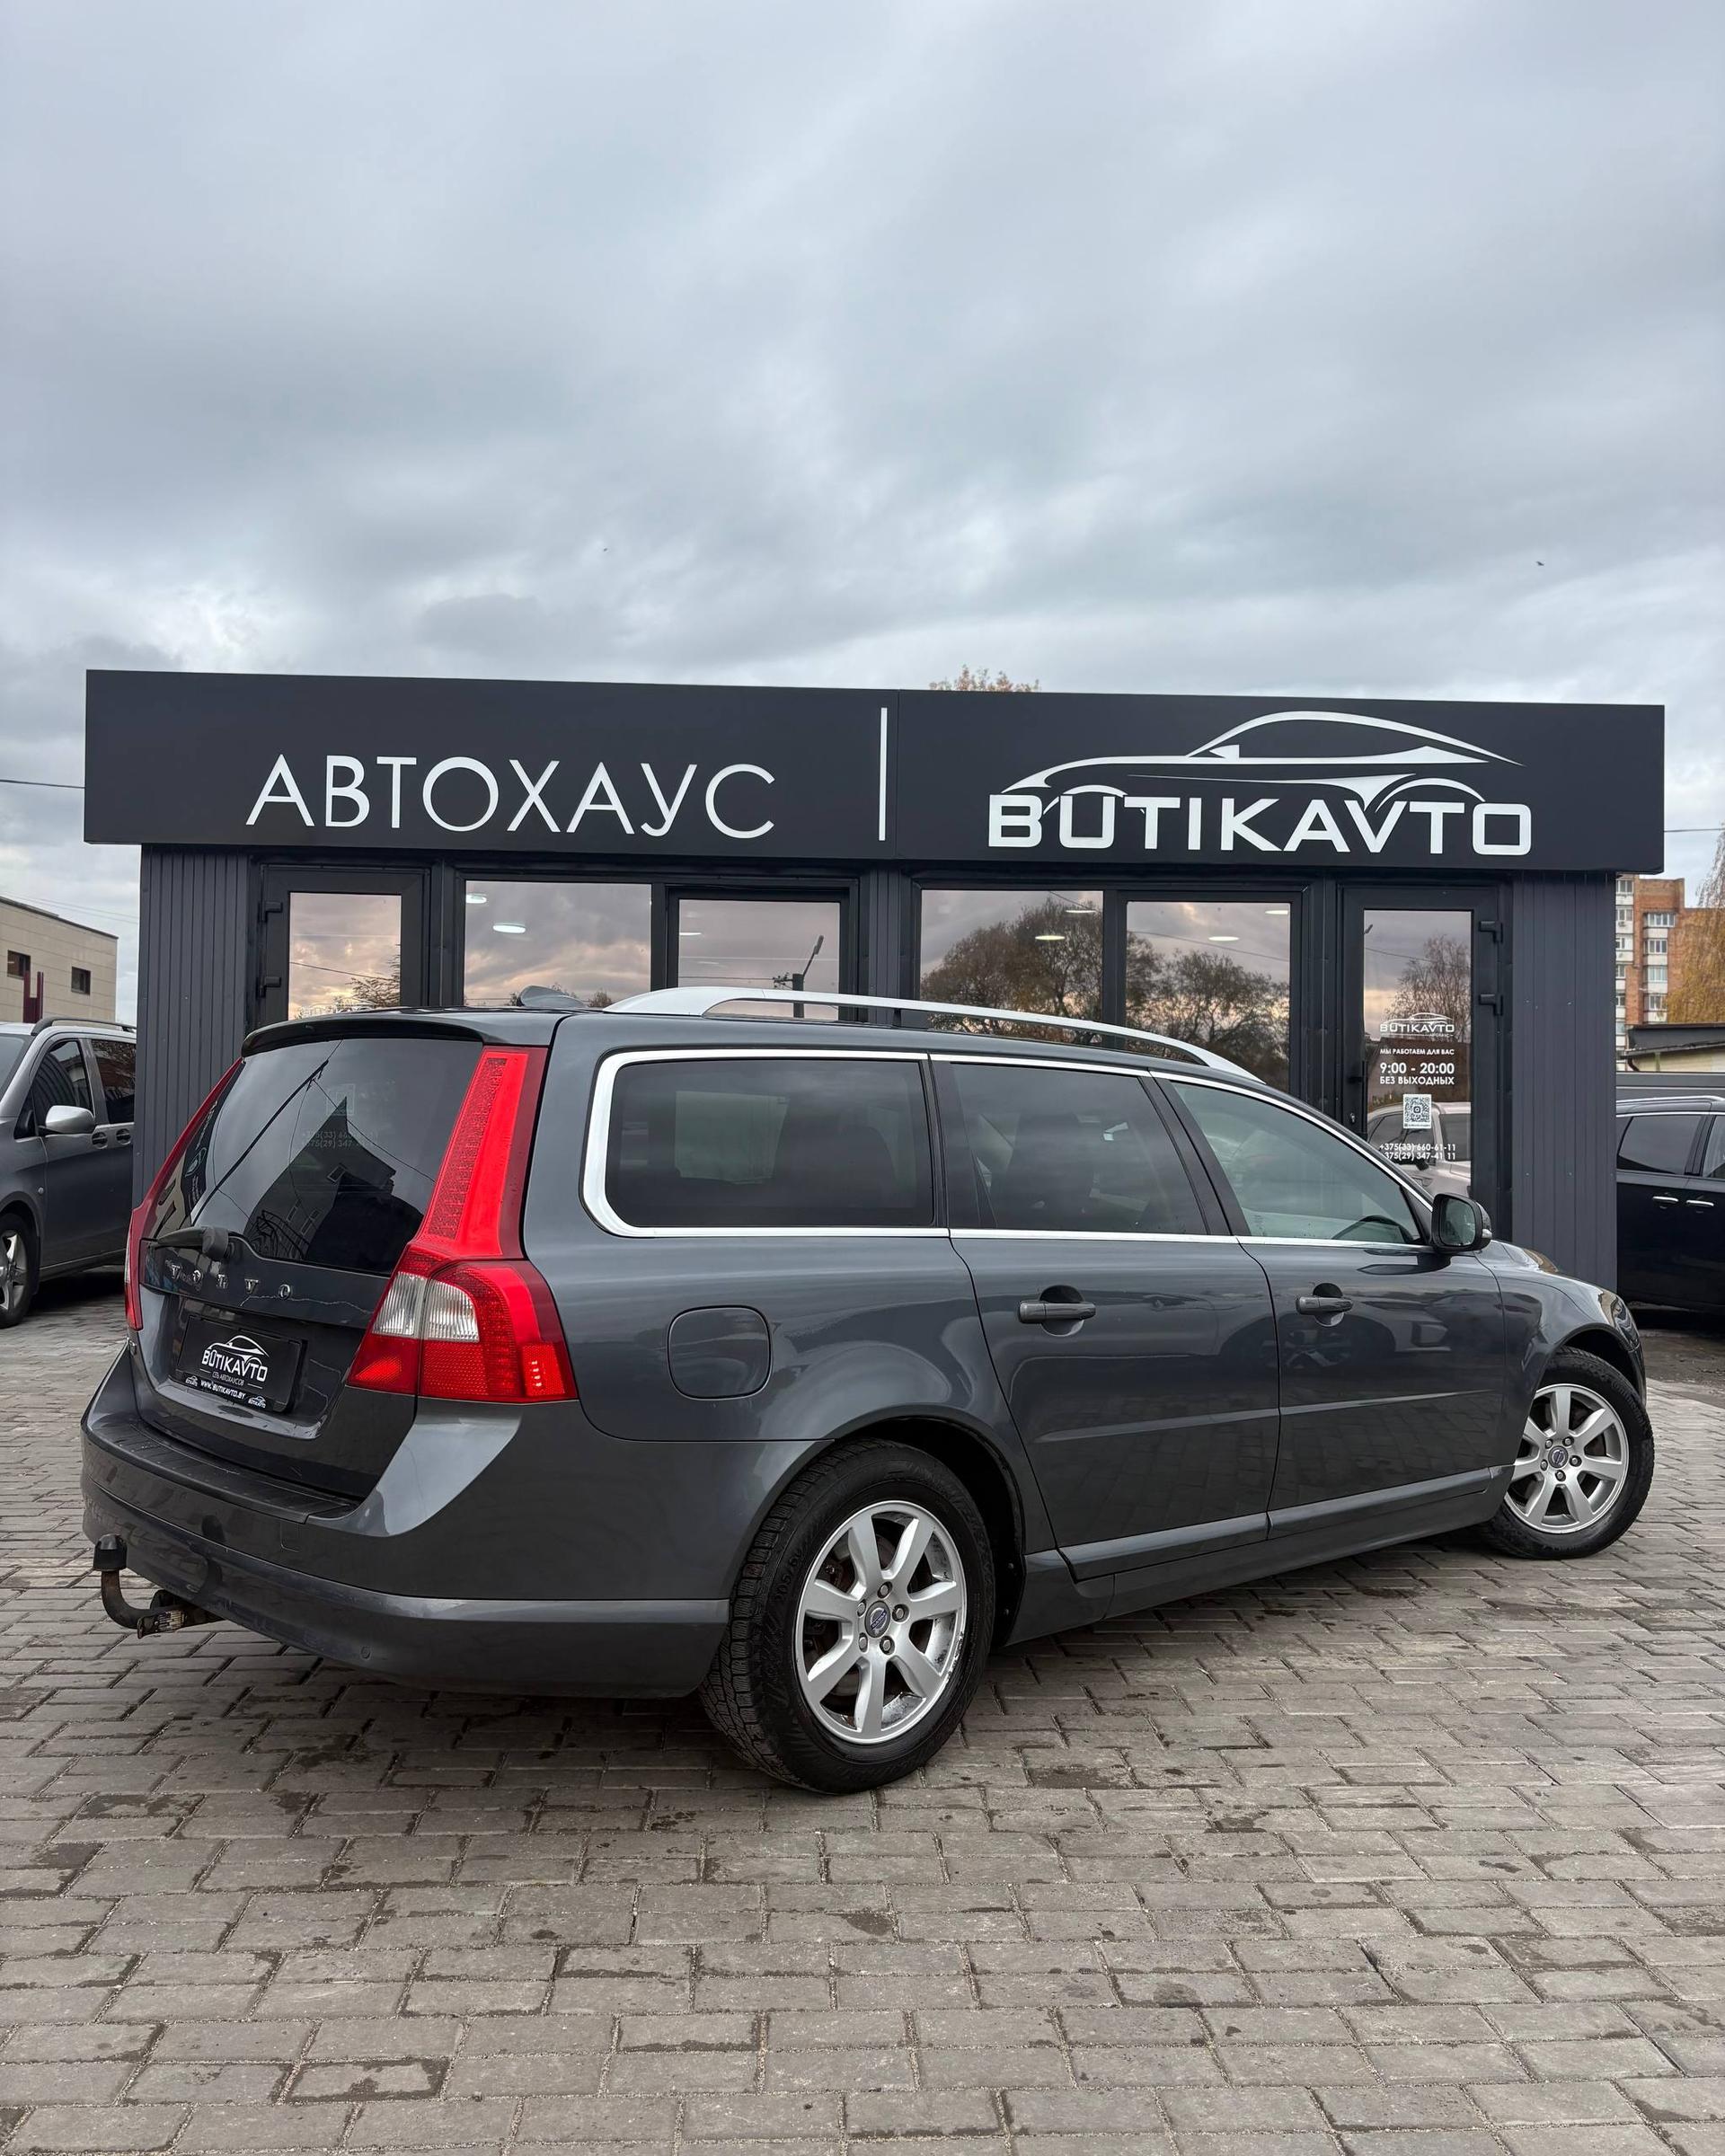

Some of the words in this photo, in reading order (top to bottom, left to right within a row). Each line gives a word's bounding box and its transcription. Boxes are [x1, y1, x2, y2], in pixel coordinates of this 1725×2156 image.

[246, 754, 774, 838] АВТОХАУС
[988, 793, 1531, 855] BUTIKAVTO
[1379, 1023, 1455, 1032] BUTIKAVTO
[1379, 1062, 1407, 1074] 9:00
[1420, 1062, 1455, 1074] 20:00
[1379, 1076, 1395, 1084] БЕЗ
[1397, 1076, 1455, 1085] ВЫХОДНЫХ
[1379, 1143, 1414, 1153] +375(33)
[1416, 1143, 1455, 1152] 660-61-11
[1384, 1151, 1414, 1162] 375(29)
[1416, 1152, 1455, 1161] 347-4111
[201, 1348, 269, 1383] BUTIKAVTO
